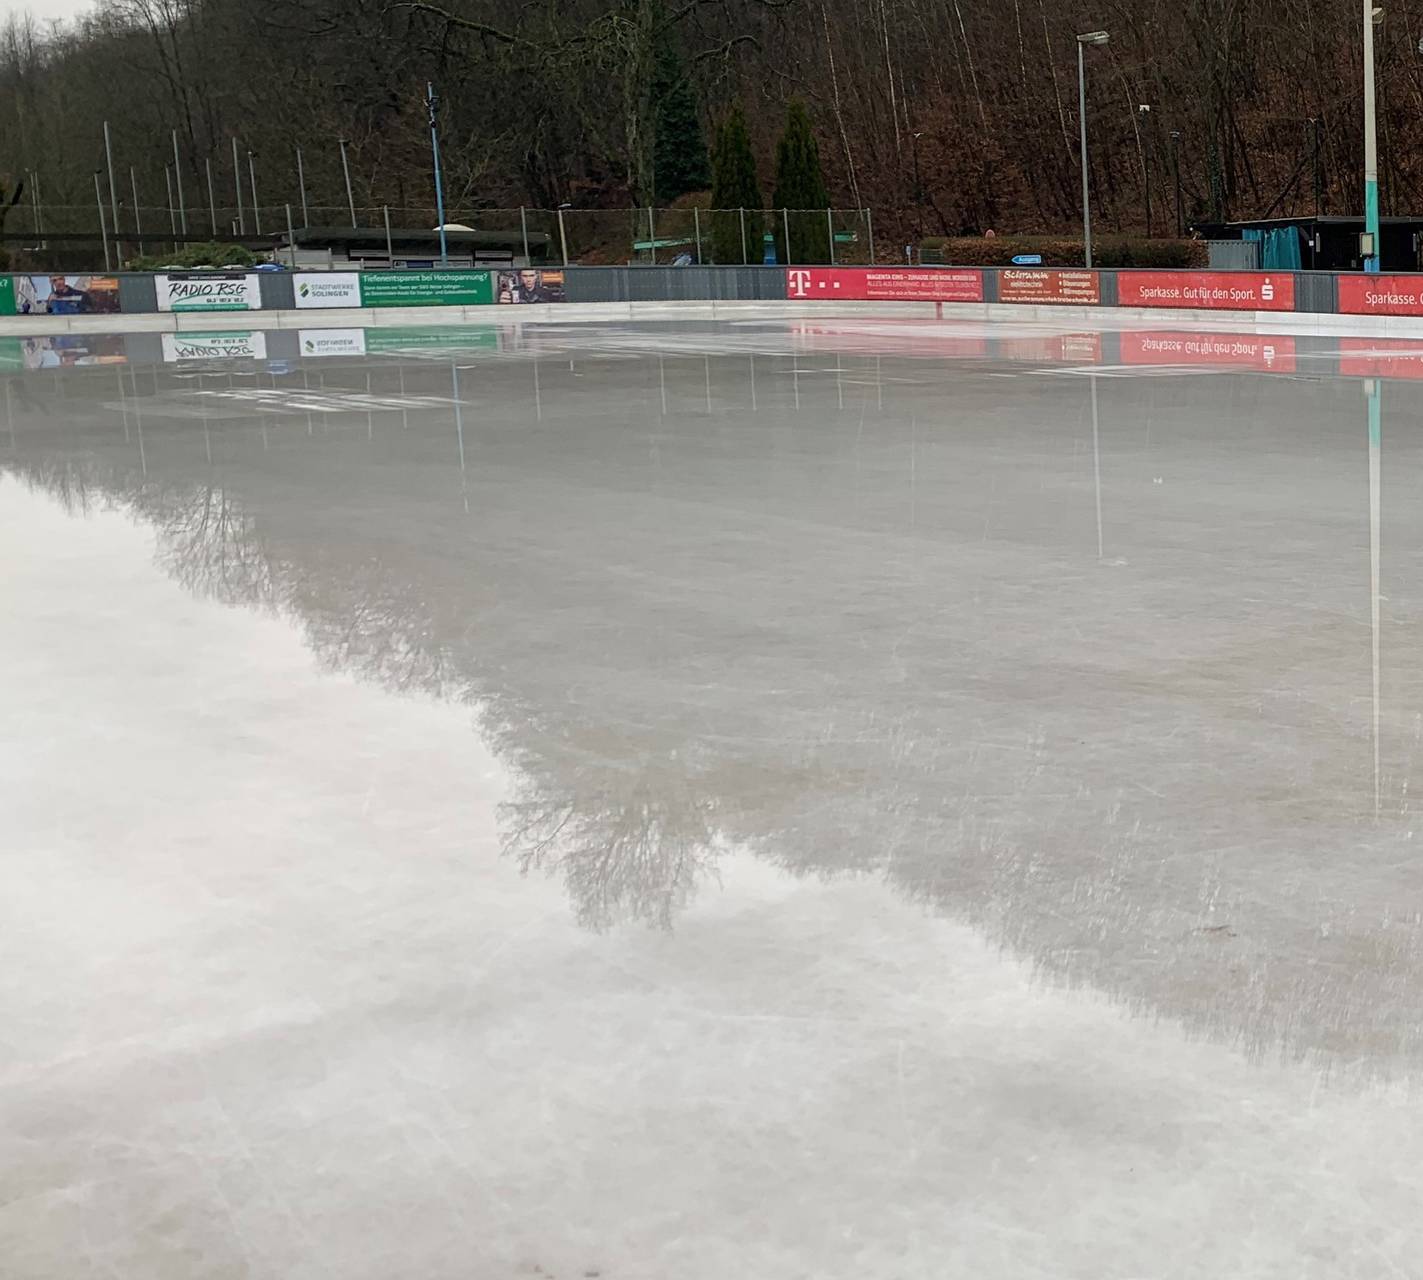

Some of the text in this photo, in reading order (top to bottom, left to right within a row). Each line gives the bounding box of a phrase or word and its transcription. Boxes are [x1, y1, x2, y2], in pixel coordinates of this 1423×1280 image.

[363, 272, 488, 283] Tiefenentspannt bei Hochspannung?
[168, 283, 247, 296] RADIO RSG
[1139, 286, 1256, 301] Sparkasse. Gut für den Sport.
[1365, 291, 1418, 306] Sparkasse.
